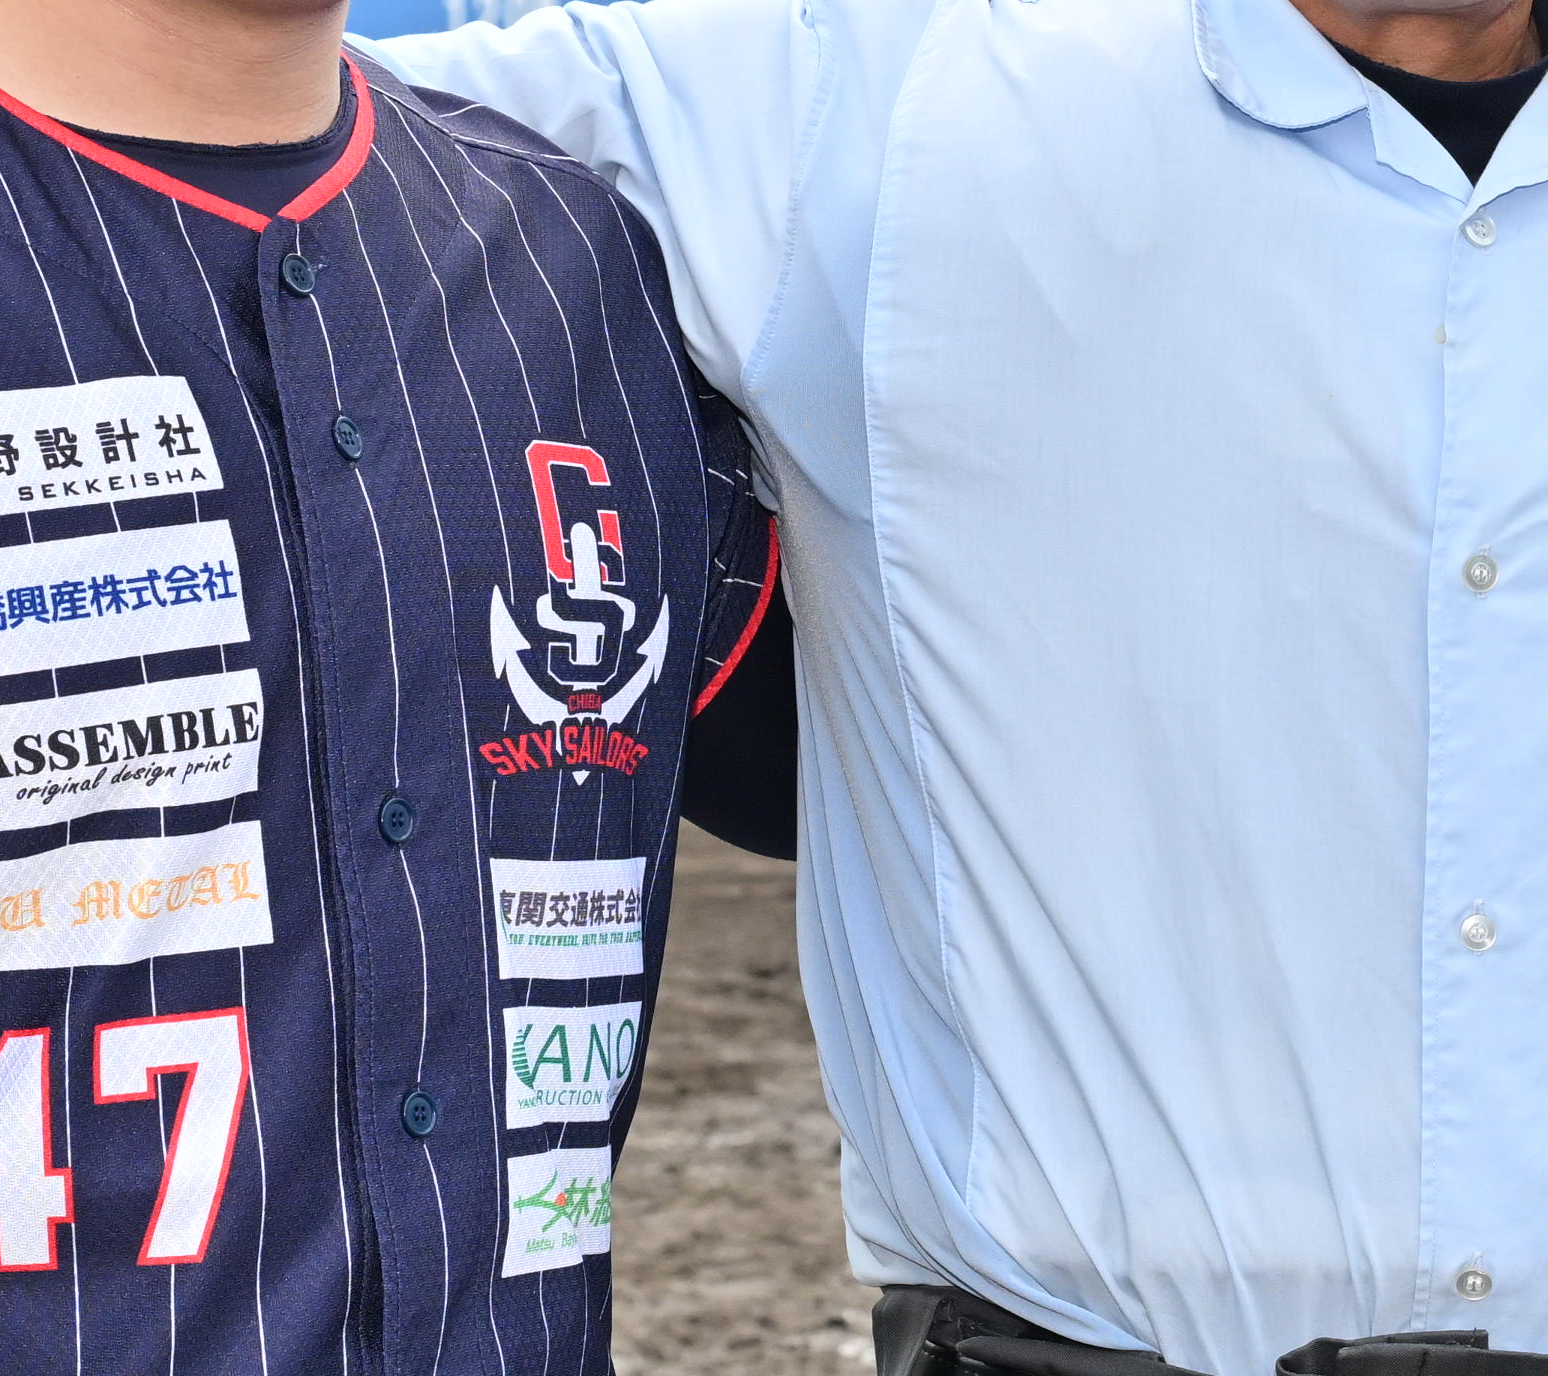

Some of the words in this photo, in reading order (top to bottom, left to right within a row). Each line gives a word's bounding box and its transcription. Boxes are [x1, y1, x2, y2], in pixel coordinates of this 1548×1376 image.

[19, 466, 207, 503] SEKKEISHA
[479, 729, 555, 776] SKY
[564, 725, 649, 776] SAILORS
[16, 766, 104, 805] original
[110, 758, 177, 790] design
[182, 751, 232, 785] print
[70, 860, 261, 926] METAL
